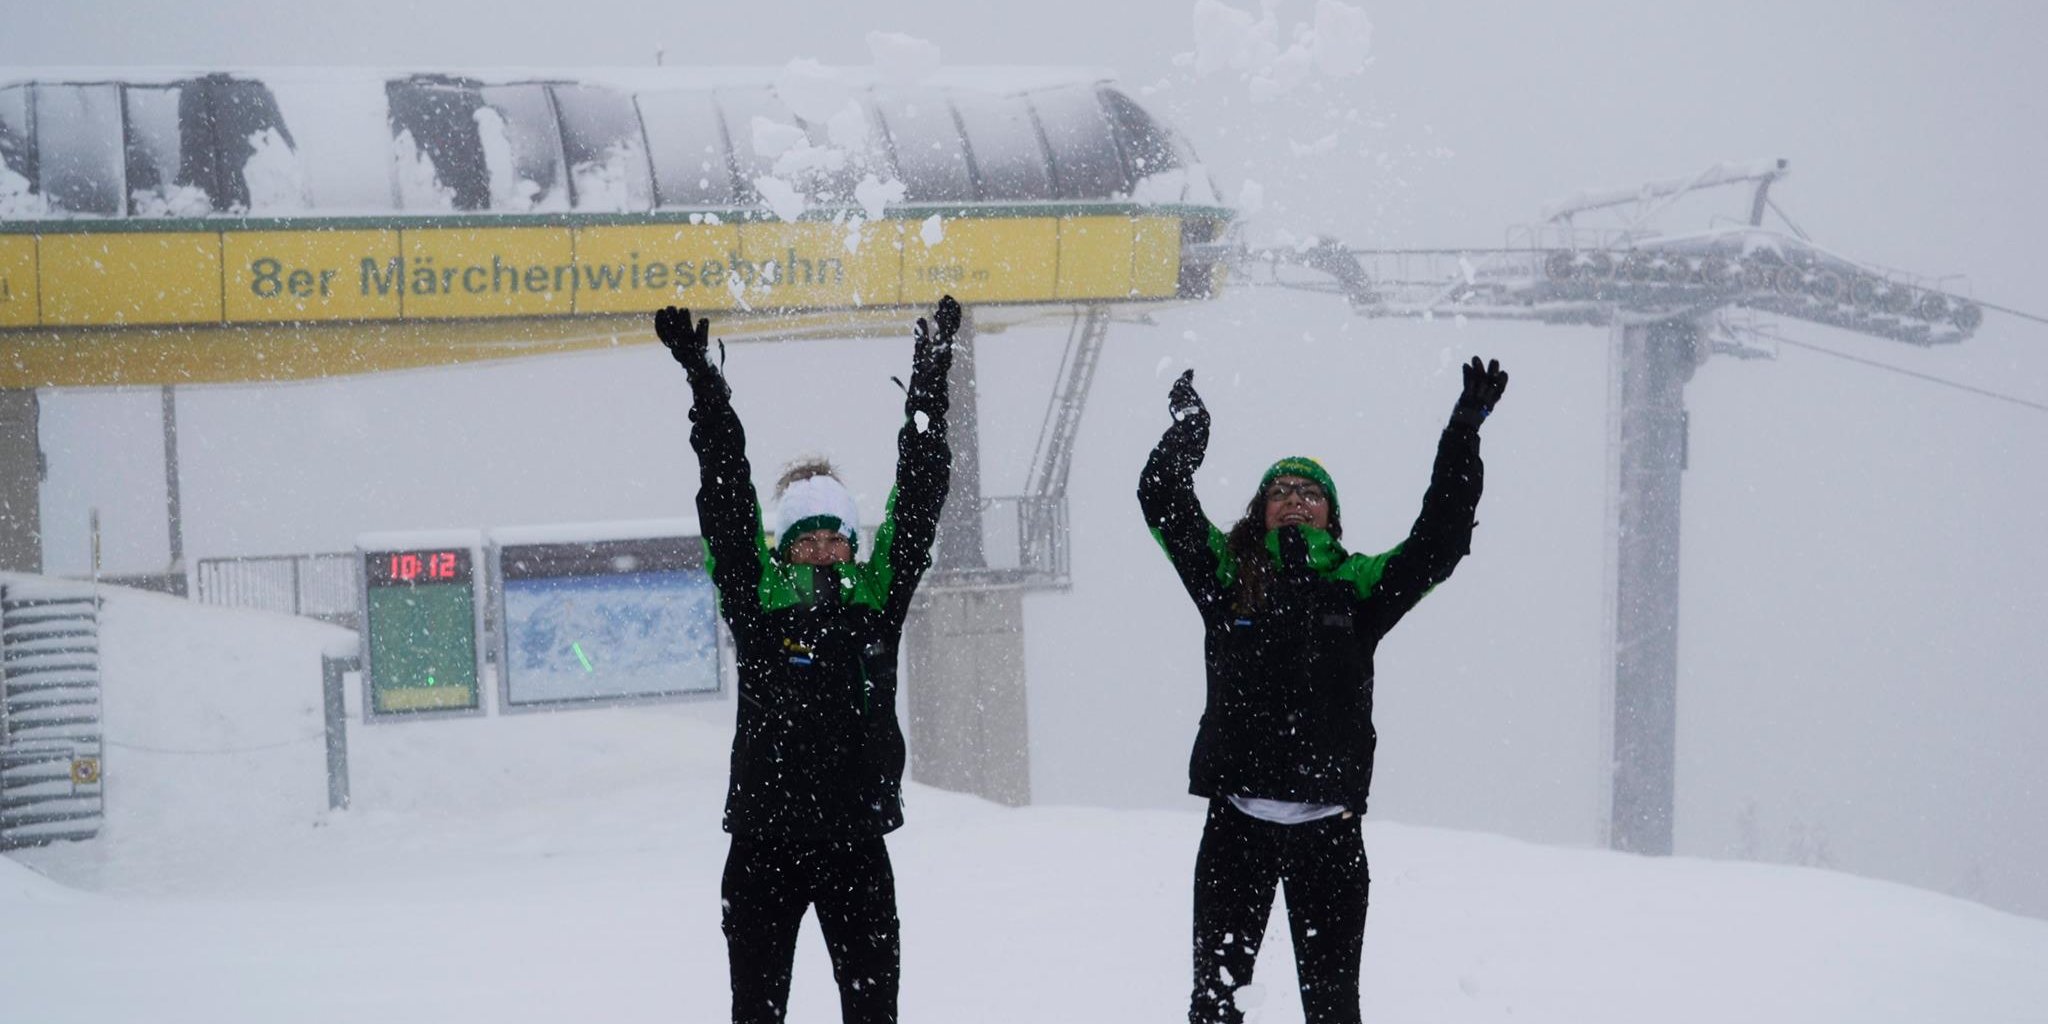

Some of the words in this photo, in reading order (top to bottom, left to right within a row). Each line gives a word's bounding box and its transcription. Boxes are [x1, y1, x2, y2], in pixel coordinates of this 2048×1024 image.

[250, 257, 337, 299] 8er
[360, 248, 843, 298] Märchenwiesebahn
[391, 551, 456, 580] 10:12
